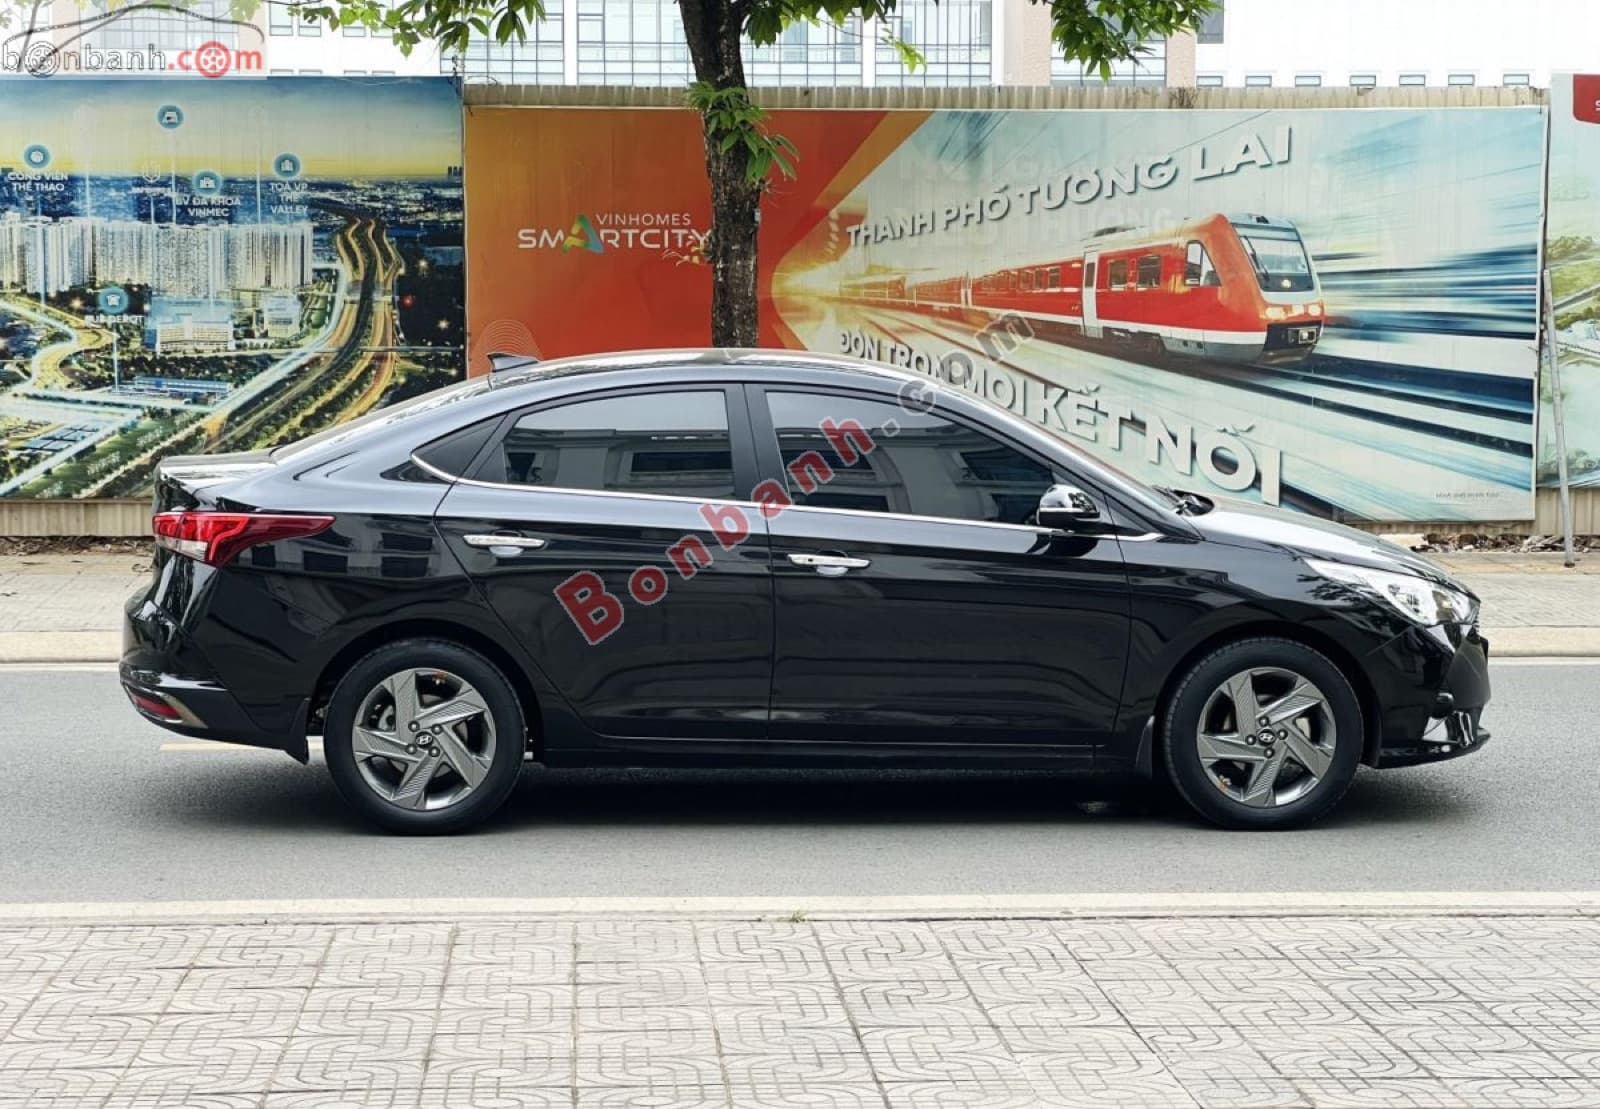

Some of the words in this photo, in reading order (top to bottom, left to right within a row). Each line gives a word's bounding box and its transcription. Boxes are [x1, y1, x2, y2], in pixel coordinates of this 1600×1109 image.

[34, 182, 65, 191] THAO
[846, 207, 936, 248] THANH
[1192, 125, 1292, 181] LAI
[187, 207, 230, 217] VINMEC
[596, 213, 692, 226] VINHOMES
[517, 213, 712, 254] SMARTCITY
[1147, 415, 1282, 508] NỐI
